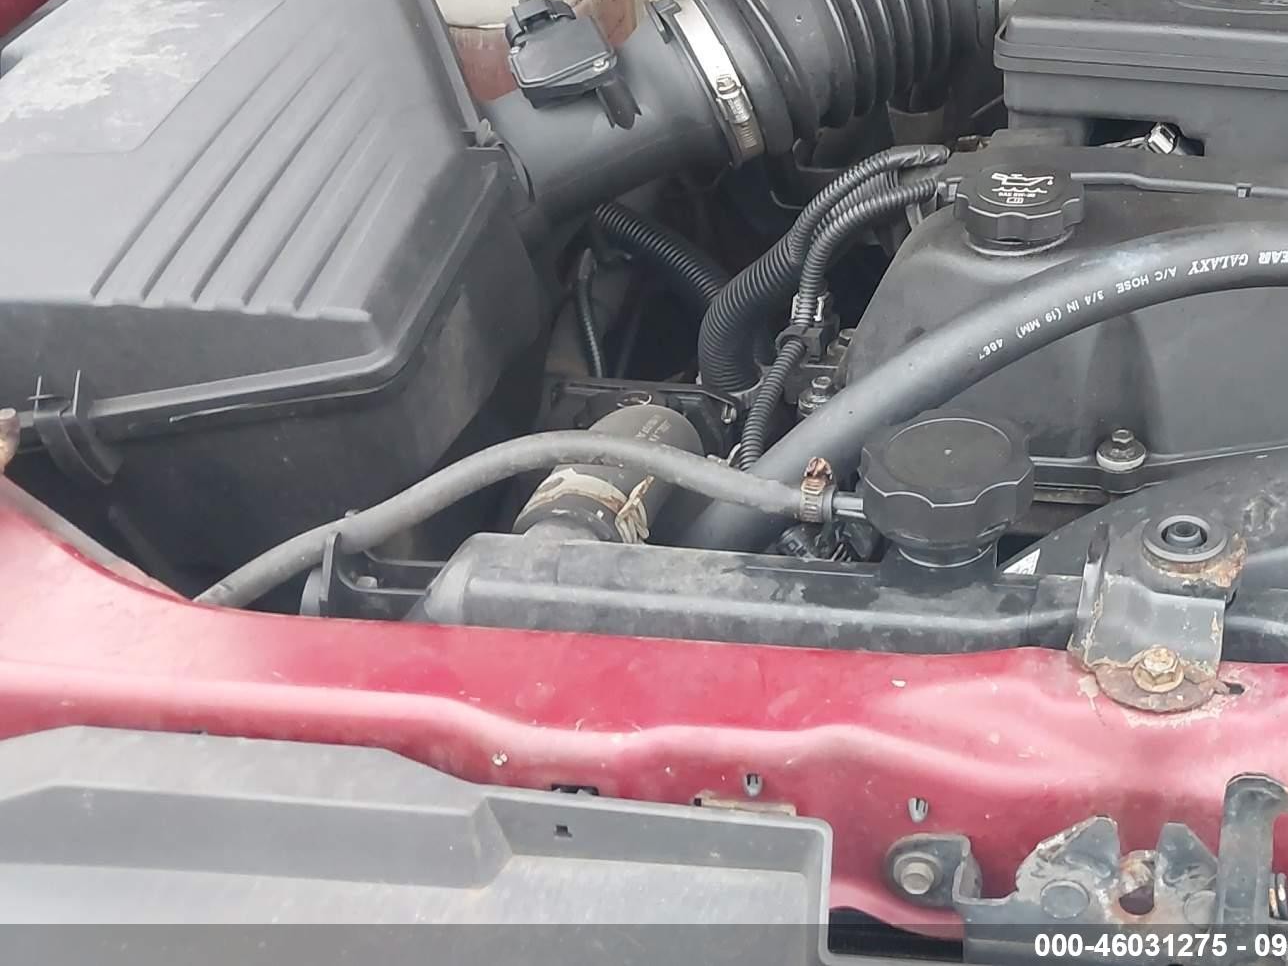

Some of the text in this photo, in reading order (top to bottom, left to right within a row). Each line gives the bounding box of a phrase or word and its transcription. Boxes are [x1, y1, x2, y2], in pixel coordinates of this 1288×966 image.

[1188, 252, 1249, 275] GALAXY
[1154, 265, 1178, 282] A/C
[1115, 273, 1150, 295] HOSE
[1083, 289, 1105, 307] 3/4
[1044, 306, 1062, 324] (19
[1066, 299, 1080, 316] IN
[1015, 316, 1040, 339] MM)
